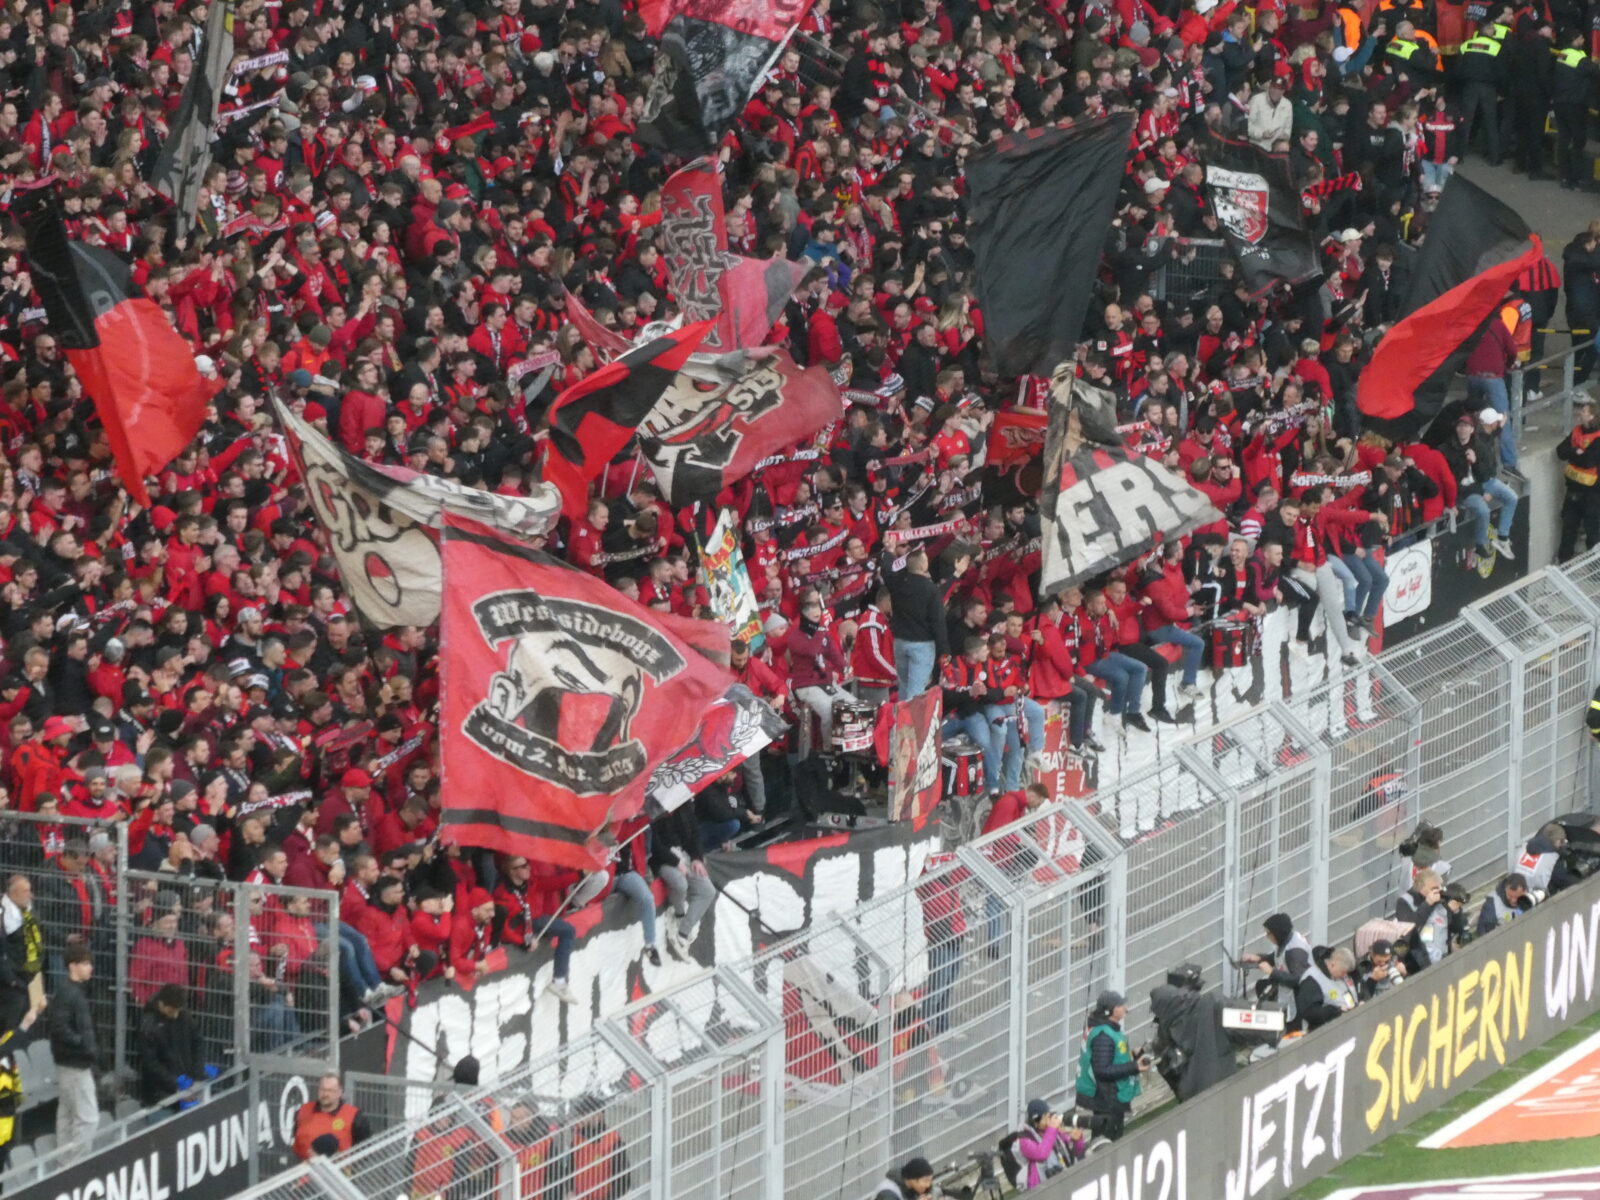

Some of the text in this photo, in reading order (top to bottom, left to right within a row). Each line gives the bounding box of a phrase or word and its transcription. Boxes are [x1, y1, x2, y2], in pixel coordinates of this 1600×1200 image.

[176, 1100, 275, 1192] IDUNA
[1224, 898, 1600, 1200] JETZT SICHERN UN
